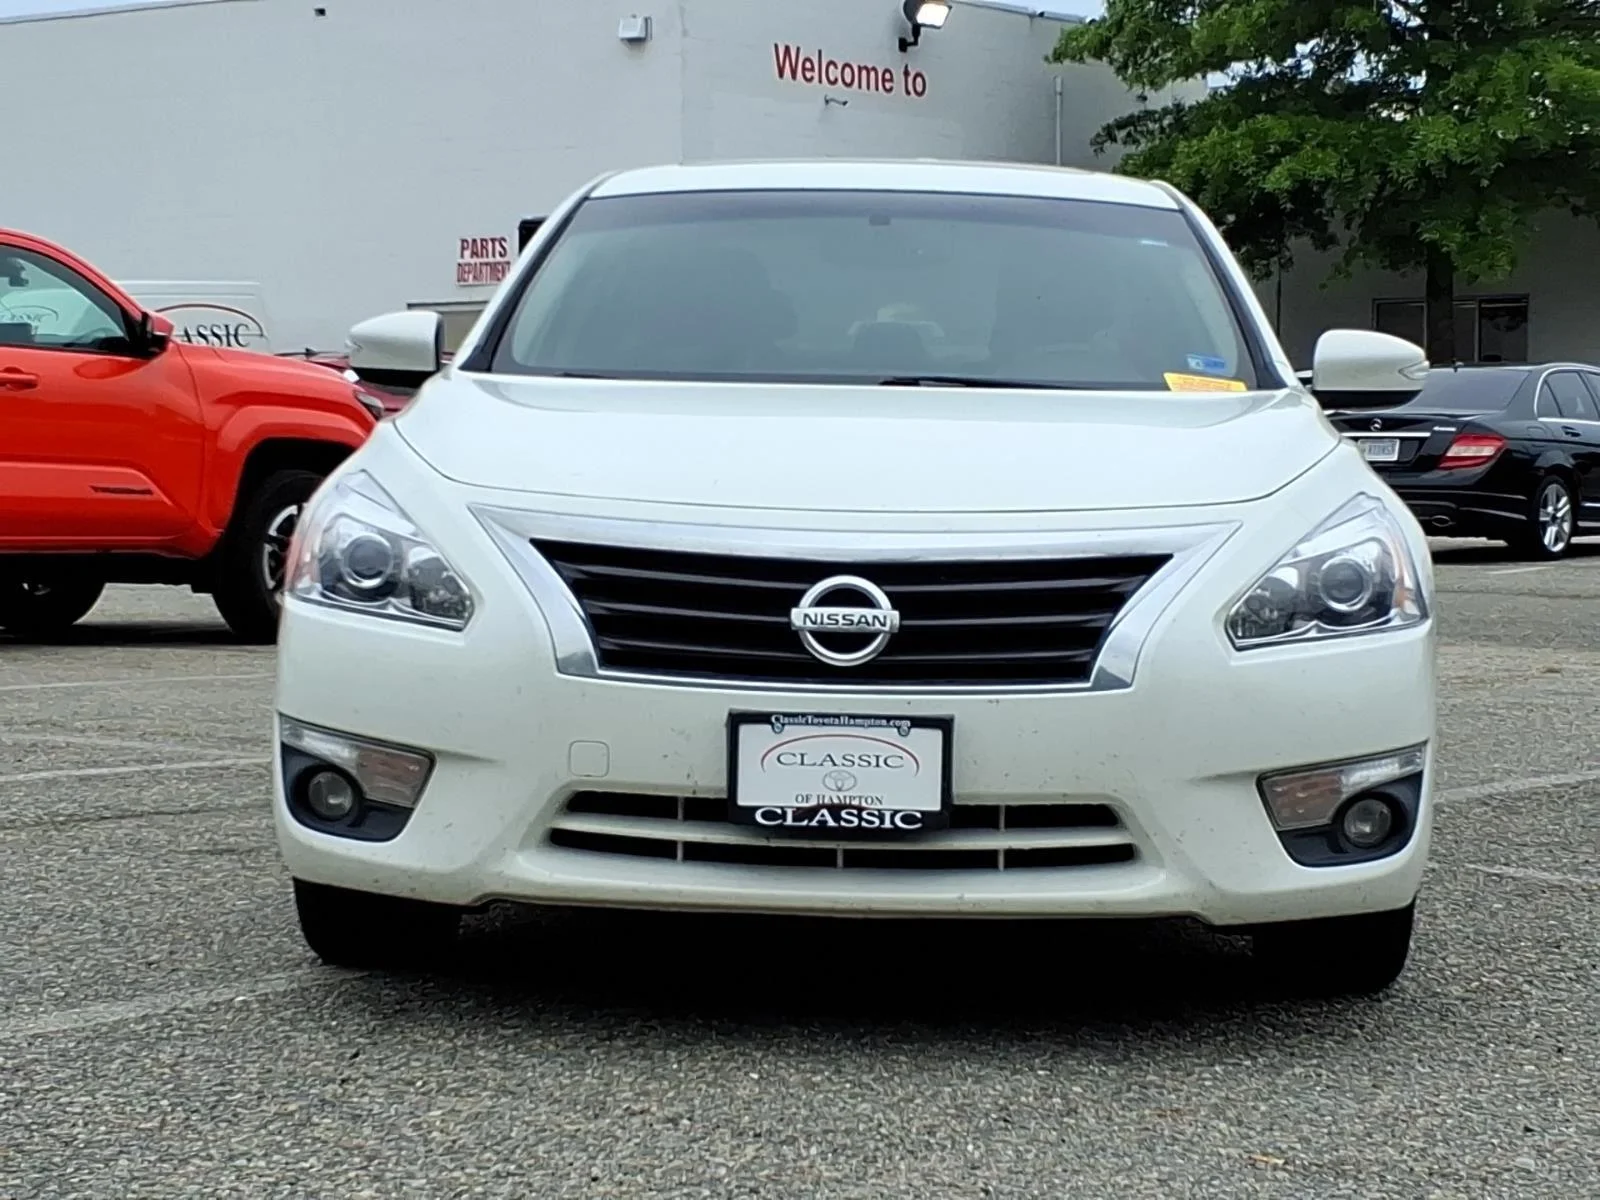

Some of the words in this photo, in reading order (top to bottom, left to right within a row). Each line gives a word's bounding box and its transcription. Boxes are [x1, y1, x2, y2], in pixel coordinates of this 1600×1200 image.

[774, 43, 894, 94] Welcome
[903, 63, 926, 97] to
[460, 237, 507, 259] PARTS
[181, 323, 249, 347] ASSIC
[803, 612, 887, 627] NISSAN
[776, 752, 904, 769] CLASSIC
[795, 793, 813, 804] OF
[816, 793, 883, 806] HAMPTON
[755, 807, 923, 829] CLASSIC
